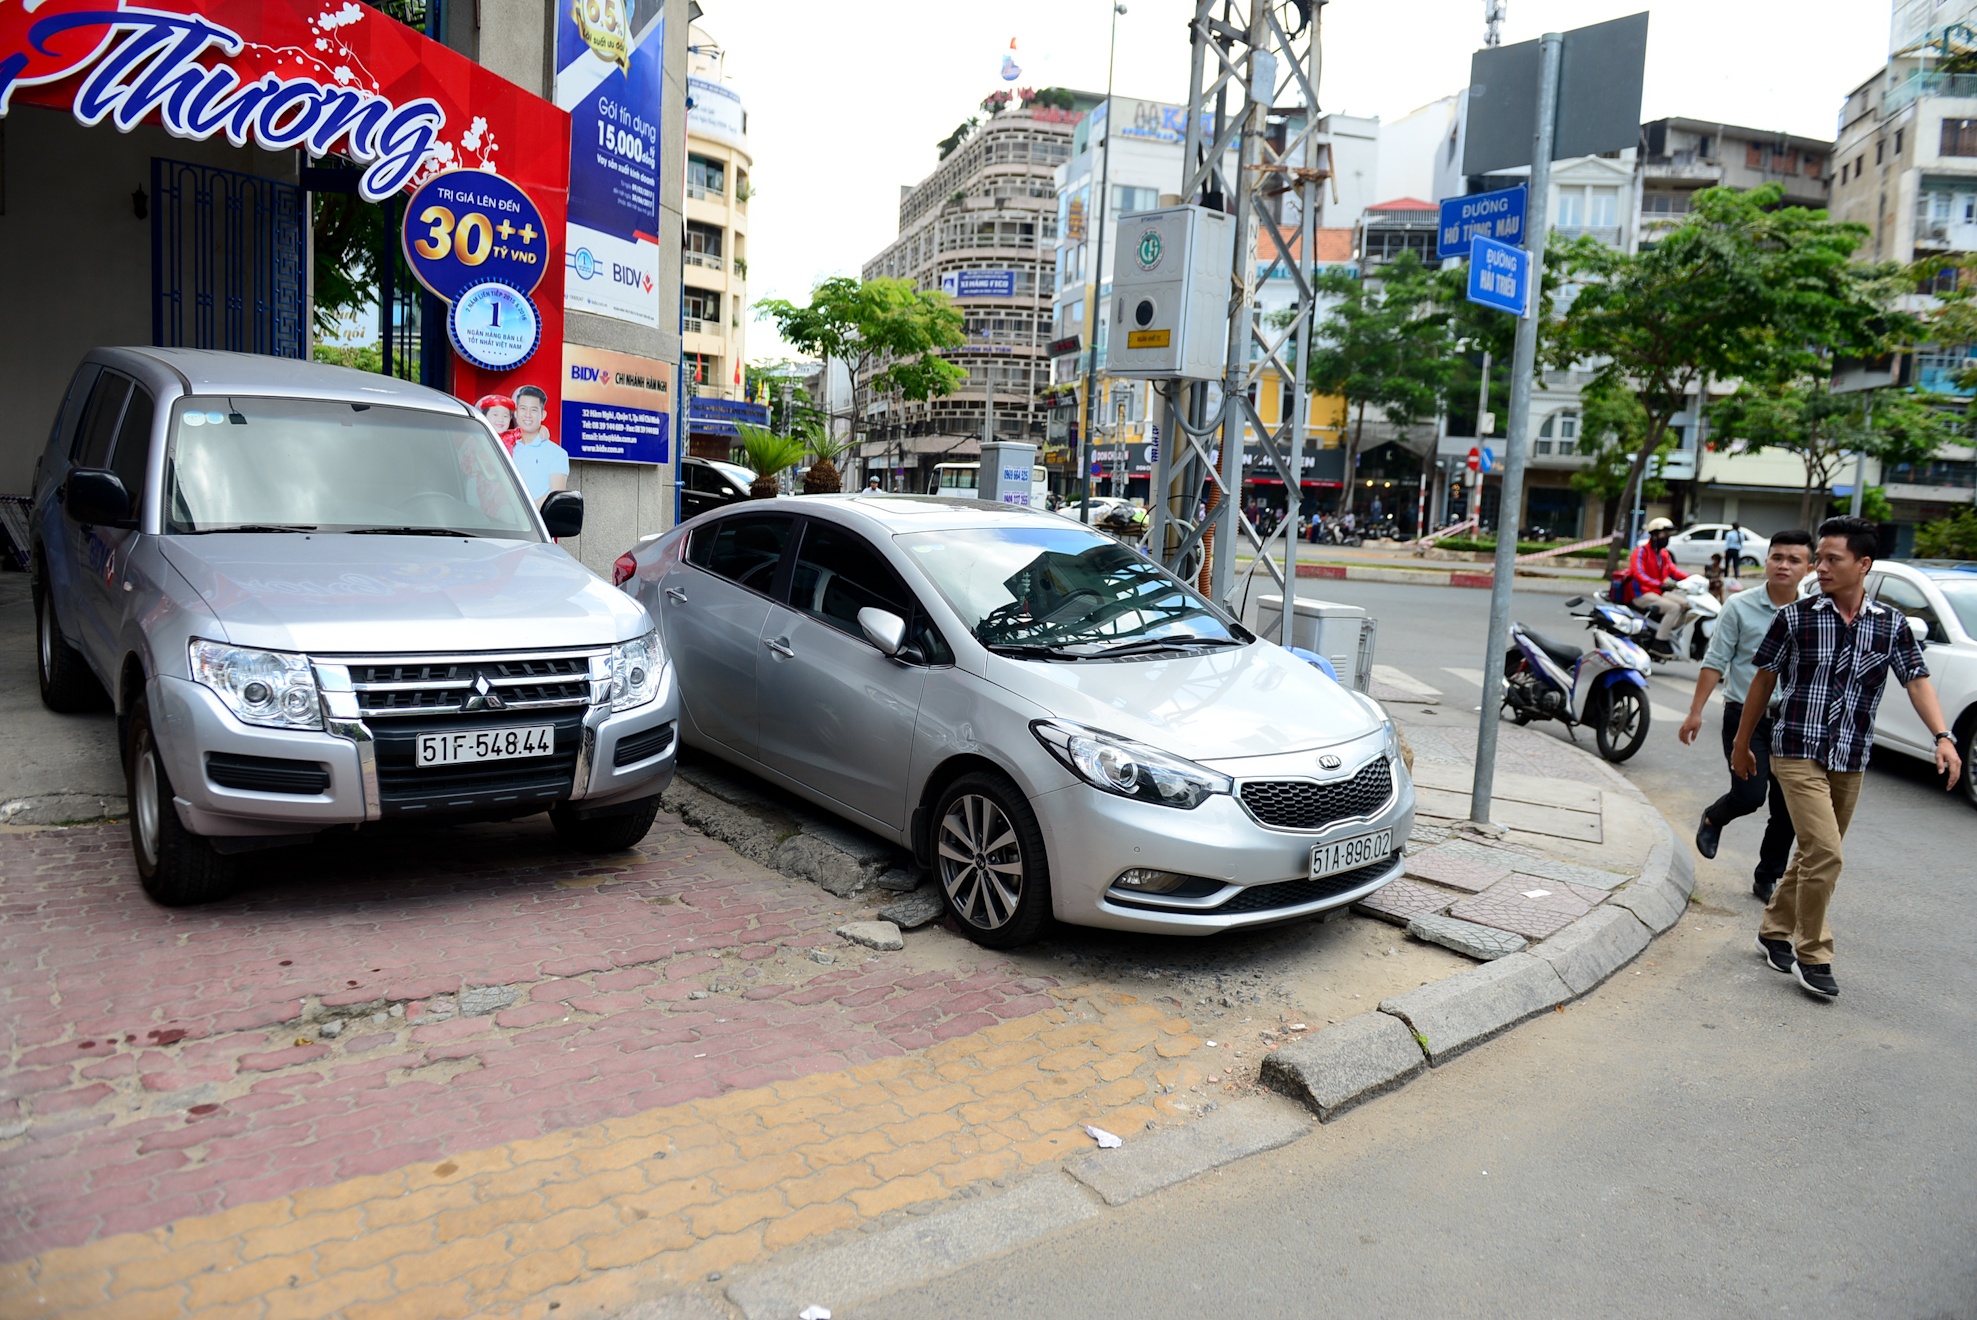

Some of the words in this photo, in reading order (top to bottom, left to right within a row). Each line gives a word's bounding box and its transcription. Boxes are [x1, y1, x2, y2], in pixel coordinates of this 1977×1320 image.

[28, 11, 445, 200] Thương
[599, 96, 618, 120] Gói
[620, 106, 631, 128] tín
[633, 115, 656, 144] dụng
[598, 120, 643, 162] 15,000
[597, 153, 607, 167] Vay
[618, 164, 630, 175] xuất
[641, 173, 655, 187] doanh
[437, 187, 454, 202] TRỊ
[456, 191, 475, 204] GIÁ
[477, 195, 496, 209] LÊN
[498, 199, 520, 213] ĐẾN
[1462, 198, 1508, 219] ĐƯỜNG
[1443, 221, 1460, 245] HỒ
[1463, 220, 1492, 242] TÙNG
[1495, 214, 1520, 239] MẬU
[511, 249, 537, 264] VND
[1486, 248, 1517, 272] ĐƯỜNG
[613, 263, 641, 289] BIDV
[990, 280, 1009, 288] FICO
[1480, 265, 1495, 292] HẢI
[490, 301, 501, 328] 1
[467, 329, 484, 337] NGÂN
[485, 331, 501, 339] HÀNG
[468, 336, 478, 344] TỐT
[480, 338, 494, 346] NHẤT
[495, 341, 508, 349] VIỆT
[571, 365, 600, 382] BIDV
[615, 372, 625, 385] CHI
[626, 372, 645, 388] NHÁNH
[582, 409, 589, 417] 32
[423, 730, 549, 762] 51F-548.44
[1313, 832, 1390, 874] 51A-896.02
